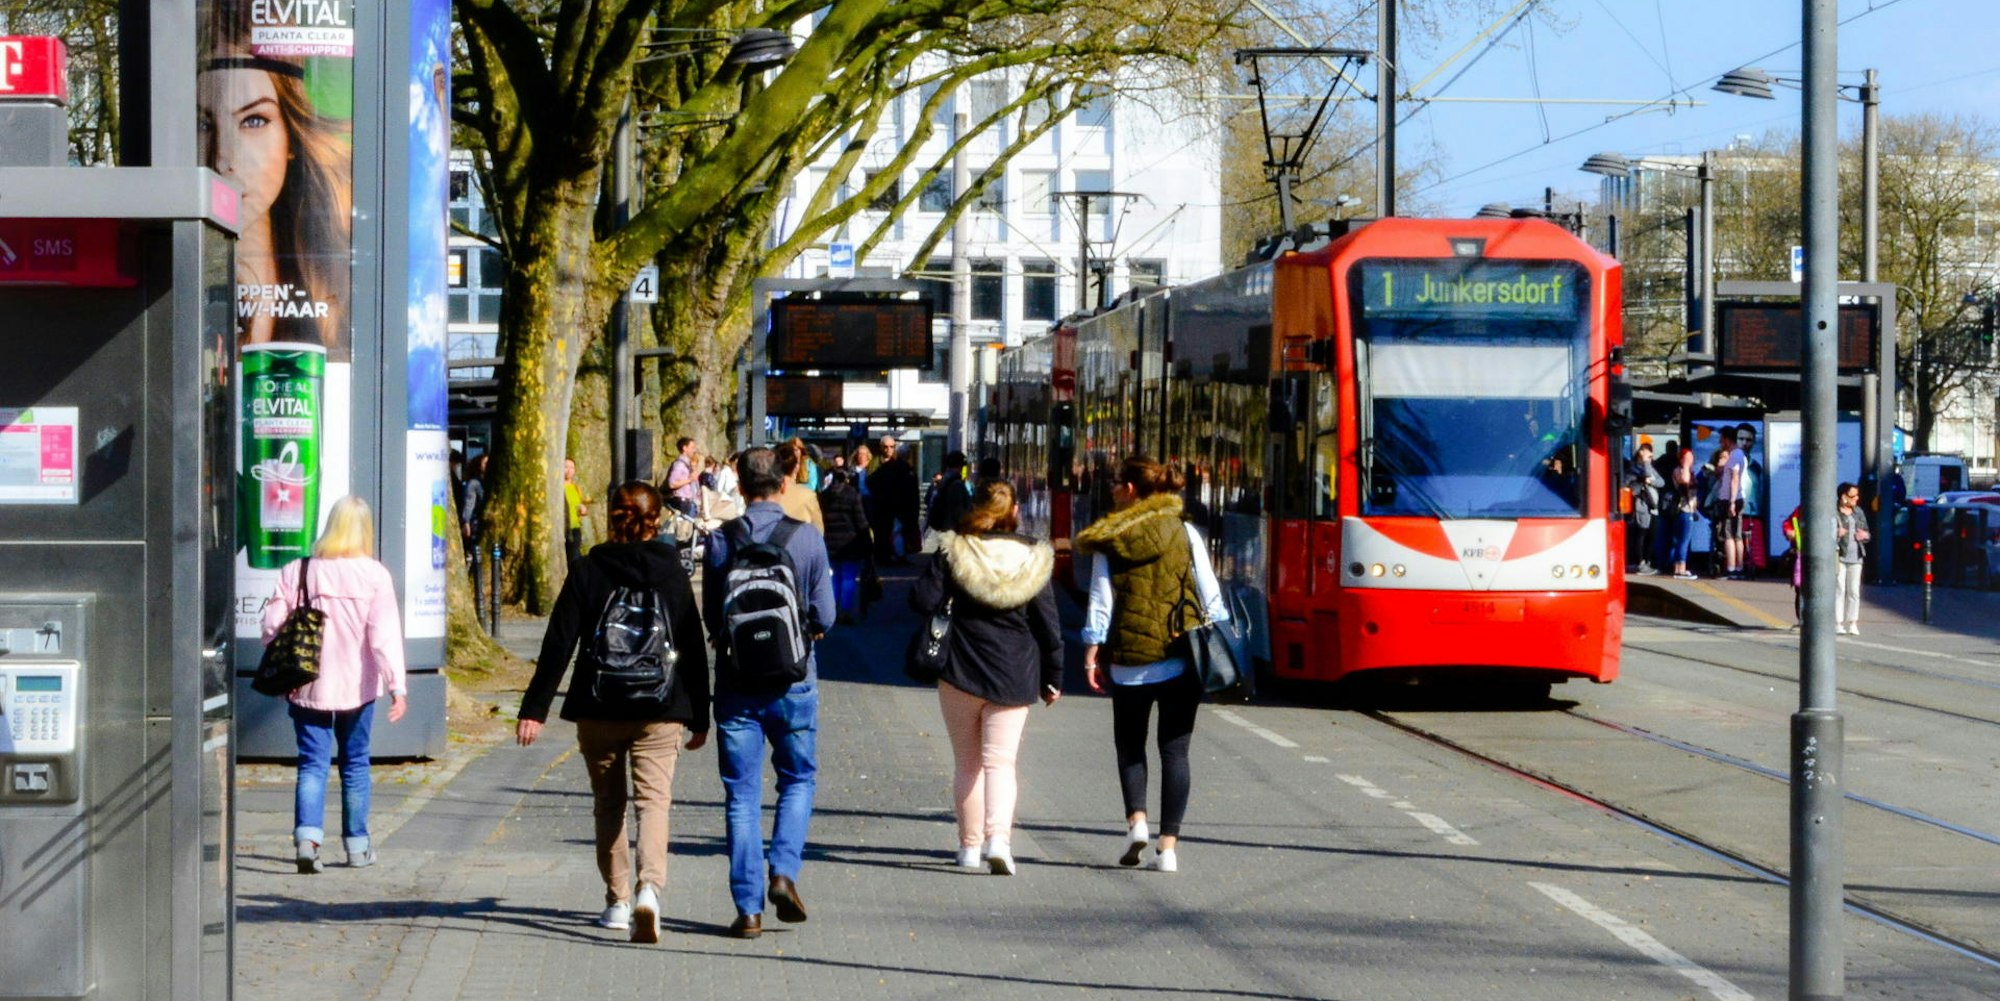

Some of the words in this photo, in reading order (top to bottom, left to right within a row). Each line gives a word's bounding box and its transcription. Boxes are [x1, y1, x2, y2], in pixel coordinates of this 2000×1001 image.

[252, 0, 346, 25] ELVITAL
[258, 31, 303, 40] PLANTA
[307, 32, 345, 40] CLEAR
[257, 44, 346, 55] ANTI-SCHUPPEN
[33, 239, 73, 256] SMS
[635, 277, 653, 298] 4
[1382, 271, 1393, 307] 1
[1416, 272, 1563, 304] Junkersdorf
[253, 397, 312, 416] ELVITAL
